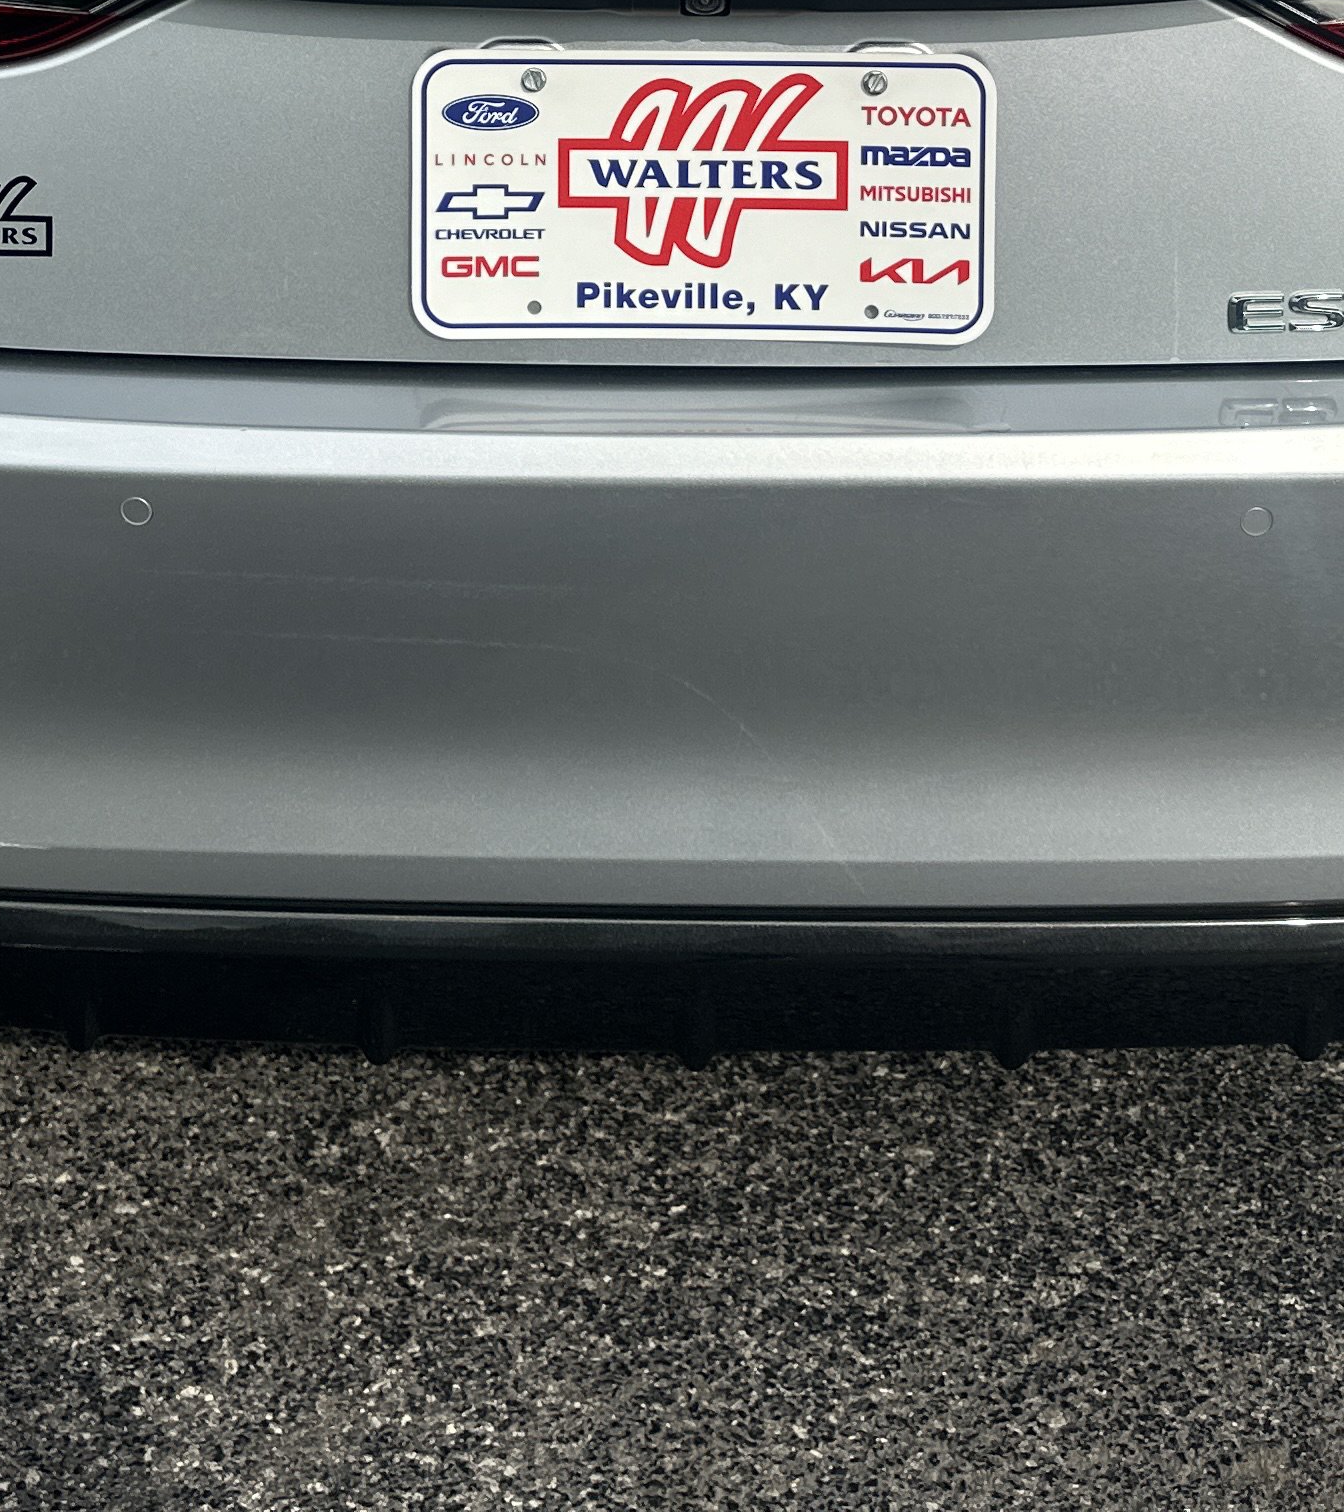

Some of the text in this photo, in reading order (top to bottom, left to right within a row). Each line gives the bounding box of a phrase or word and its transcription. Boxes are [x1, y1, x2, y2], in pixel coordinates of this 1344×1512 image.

[462, 100, 519, 124] Ford
[861, 106, 972, 128] TOYOTA
[434, 153, 546, 166] LINCOLN
[589, 159, 823, 190] WALTERS
[860, 185, 971, 204] MITSUBISHI
[435, 228, 546, 240] CHEVROLET
[860, 221, 971, 240] NISSAN
[441, 256, 540, 278] GMC
[576, 283, 829, 315] Pikeville, KY
